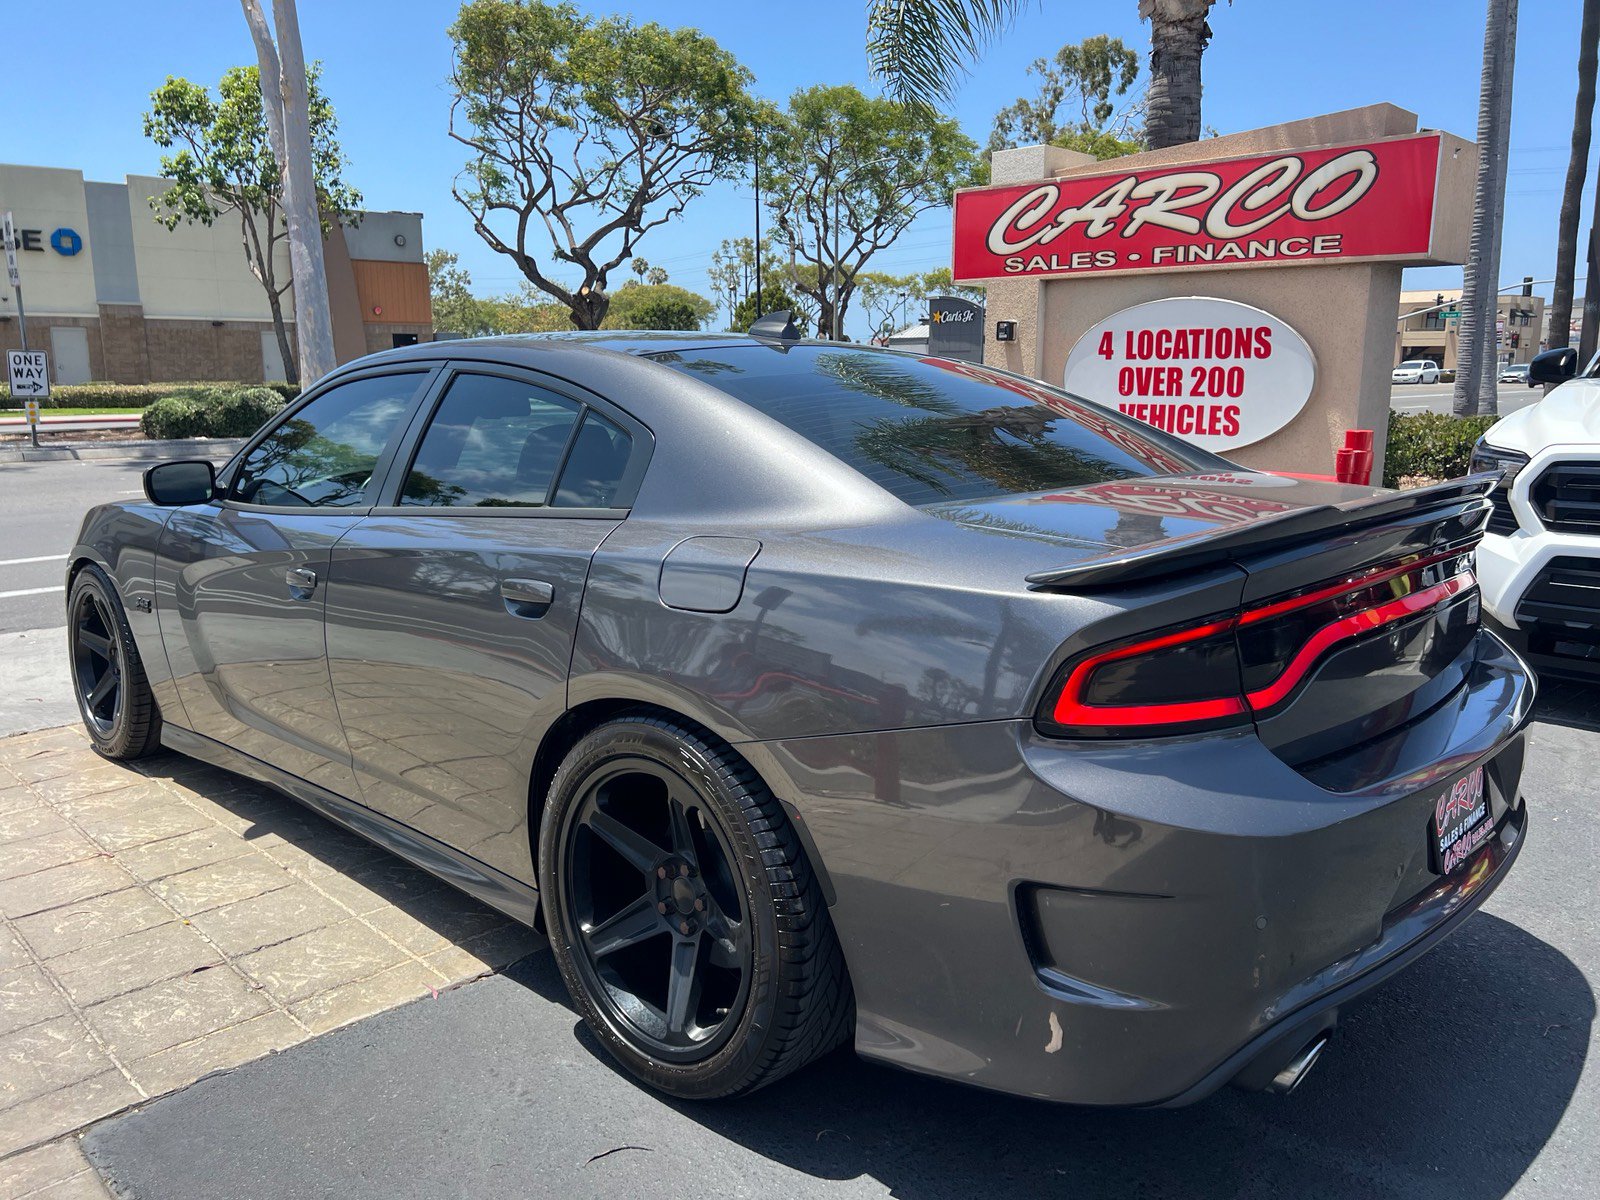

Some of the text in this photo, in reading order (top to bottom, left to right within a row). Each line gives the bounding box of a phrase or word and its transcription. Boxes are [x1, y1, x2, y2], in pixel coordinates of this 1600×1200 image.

[985, 150, 1379, 256] CARCO
[1004, 234, 1343, 273] SALES FINANCE
[941, 310, 962, 323] Carl's
[13, 354, 42, 366] ONE
[1098, 326, 1272, 361] 4 LOCATIONS
[13, 367, 44, 378] WAY
[1118, 366, 1245, 398] OVER 200
[1440, 827, 1459, 853] SALES
[1464, 801, 1486, 833] FINANCE
